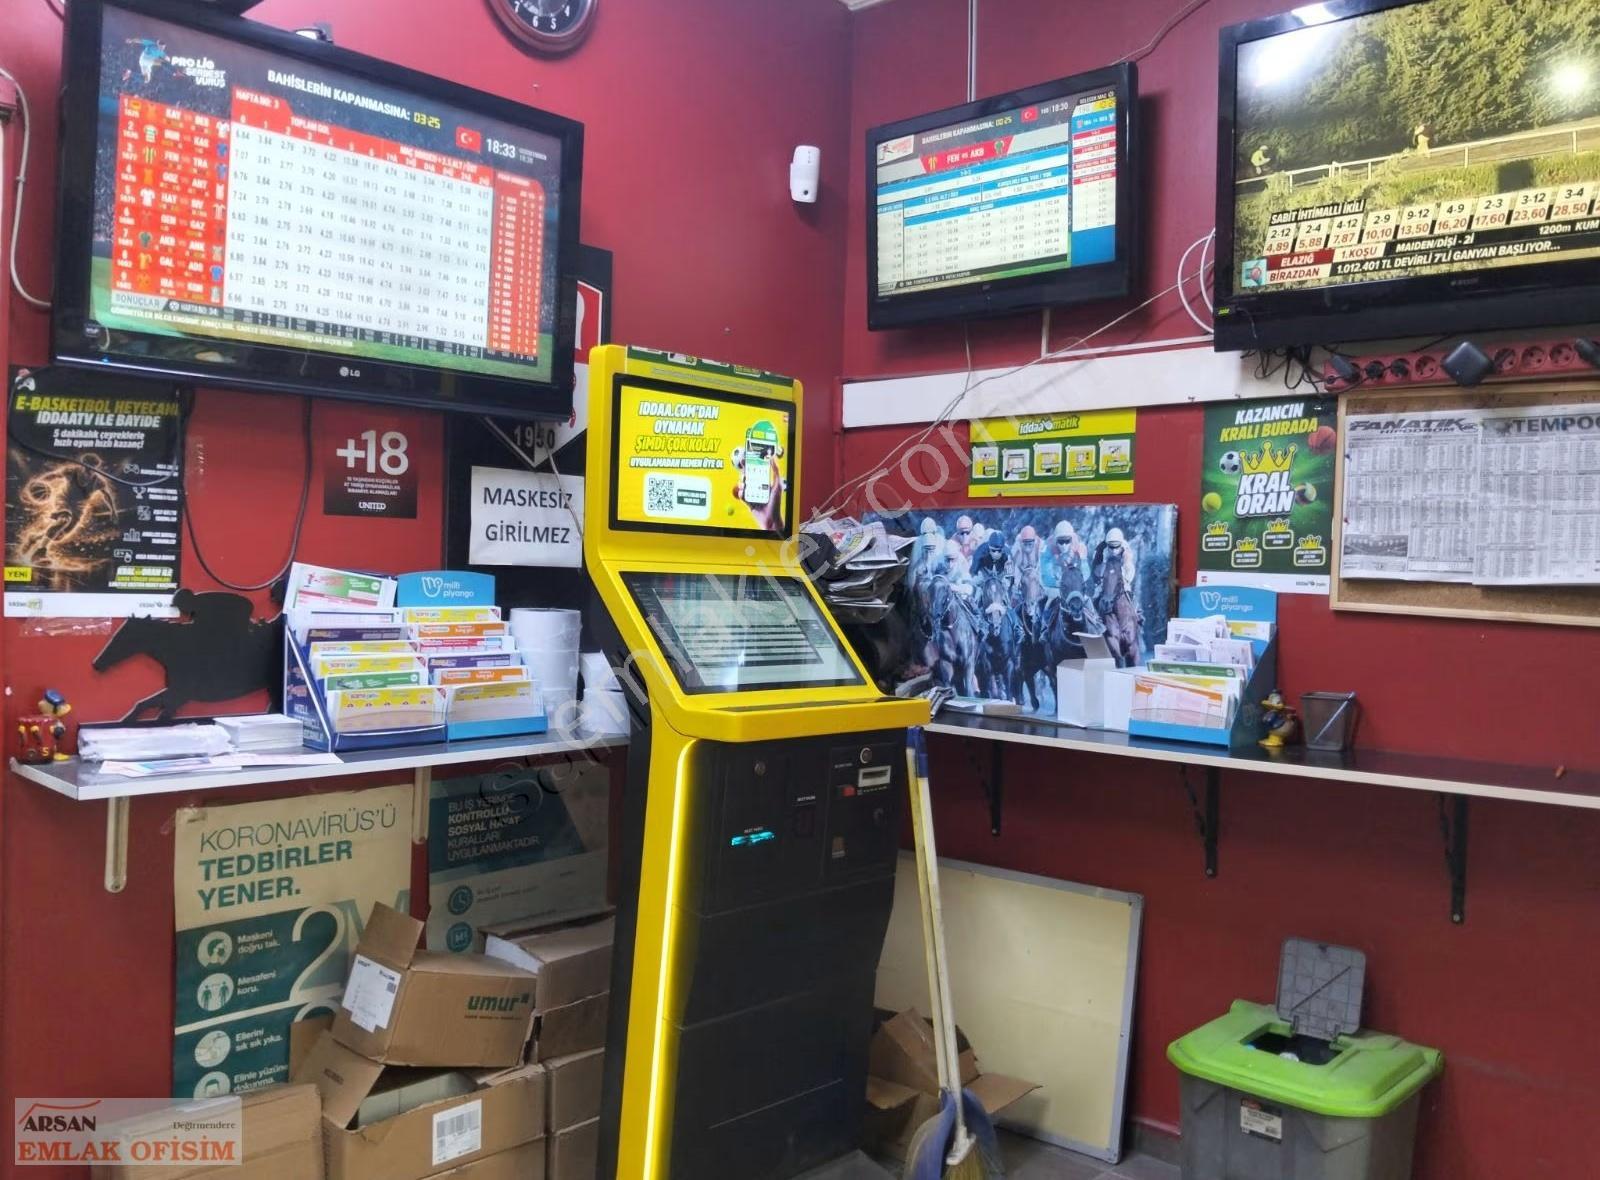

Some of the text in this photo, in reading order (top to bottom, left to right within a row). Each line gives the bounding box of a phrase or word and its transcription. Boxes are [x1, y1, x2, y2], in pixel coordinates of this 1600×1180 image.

[515, 1, 520, 13] 7
[564, 5, 570, 17] 4
[532, 16, 539, 27] 6
[550, 18, 557, 30] 5
[171, 56, 195, 68] PRO
[267, 70, 442, 129] BAHİSLERİN KAPANMASINA: 03:25
[486, 138, 516, 159] 18:33
[947, 154, 960, 164] FEN
[1521, 193, 1546, 205] 3-12
[1565, 188, 1584, 199] 3-4
[1446, 204, 1465, 214] 4-9
[1484, 199, 1503, 209] 2-3
[1271, 201, 1364, 225] SABİT İHTİMALLİ İKİLİ
[1373, 214, 1391, 224] 2-9
[1407, 208, 1430, 219] 9-12
[1305, 223, 1322, 234] 2-4
[1336, 218, 1358, 229] 4-12
[1539, 221, 1600, 235] 1200m KUM
[1270, 228, 1291, 239] 2-12
[1280, 253, 1314, 267] ELAZIĞ
[1337, 262, 1380, 275] 1.012.401
[1381, 260, 1392, 269] TL
[1394, 254, 1432, 268] DEVİRLİ
[1453, 246, 1496, 261] GANYAN
[1269, 267, 1320, 282] BİRAZDAN
[350, 369, 361, 378] LG
[15, 395, 179, 416] E-BASKETBOL HEYECANI
[1235, 403, 1305, 425] KAZANCIN
[53, 428, 145, 441] 5 dakikalık çeyreklerle
[654, 419, 705, 436] OYNAMAK
[1220, 418, 1318, 442] KRALI BURADA
[73, 440, 94, 449] oyun
[113, 439, 144, 450] kazanç!
[667, 437, 688, 454] ÇOK
[688, 438, 721, 453] KOLAY
[336, 430, 409, 476] +18
[630, 457, 680, 468] UYGULAMADAN
[680, 458, 703, 468] HEMEN
[716, 459, 724, 468] OL
[1239, 471, 1291, 495] KRAL
[358, 501, 387, 510] UNITED
[483, 487, 573, 510] MASKESİZ
[1236, 491, 1295, 515] ORAN
[485, 523, 570, 545] GİRİLMEZ
[443, 581, 460, 591] milli
[443, 588, 474, 599] piyango
[1221, 596, 1238, 604] milli
[1221, 602, 1253, 612] piyango
[448, 804, 510, 824] KONTROLLÜ
[200, 803, 397, 853] KORONAVİRÜS'Ü
[448, 816, 521, 837] SOSYAL HAYAT
[198, 840, 353, 882] TEDBİRLER
[197, 876, 301, 911] YENER.
[238, 929, 273, 944] Maskeni
[238, 940, 280, 954] doğru tak.
[238, 969, 276, 985] Mesafeni
[237, 985, 259, 995] koru.
[467, 995, 518, 1011] umur
[235, 1027, 264, 1041] Ellerini
[235, 1034, 283, 1052] sık sık yıka.
[234, 1071, 257, 1083] Elinle
